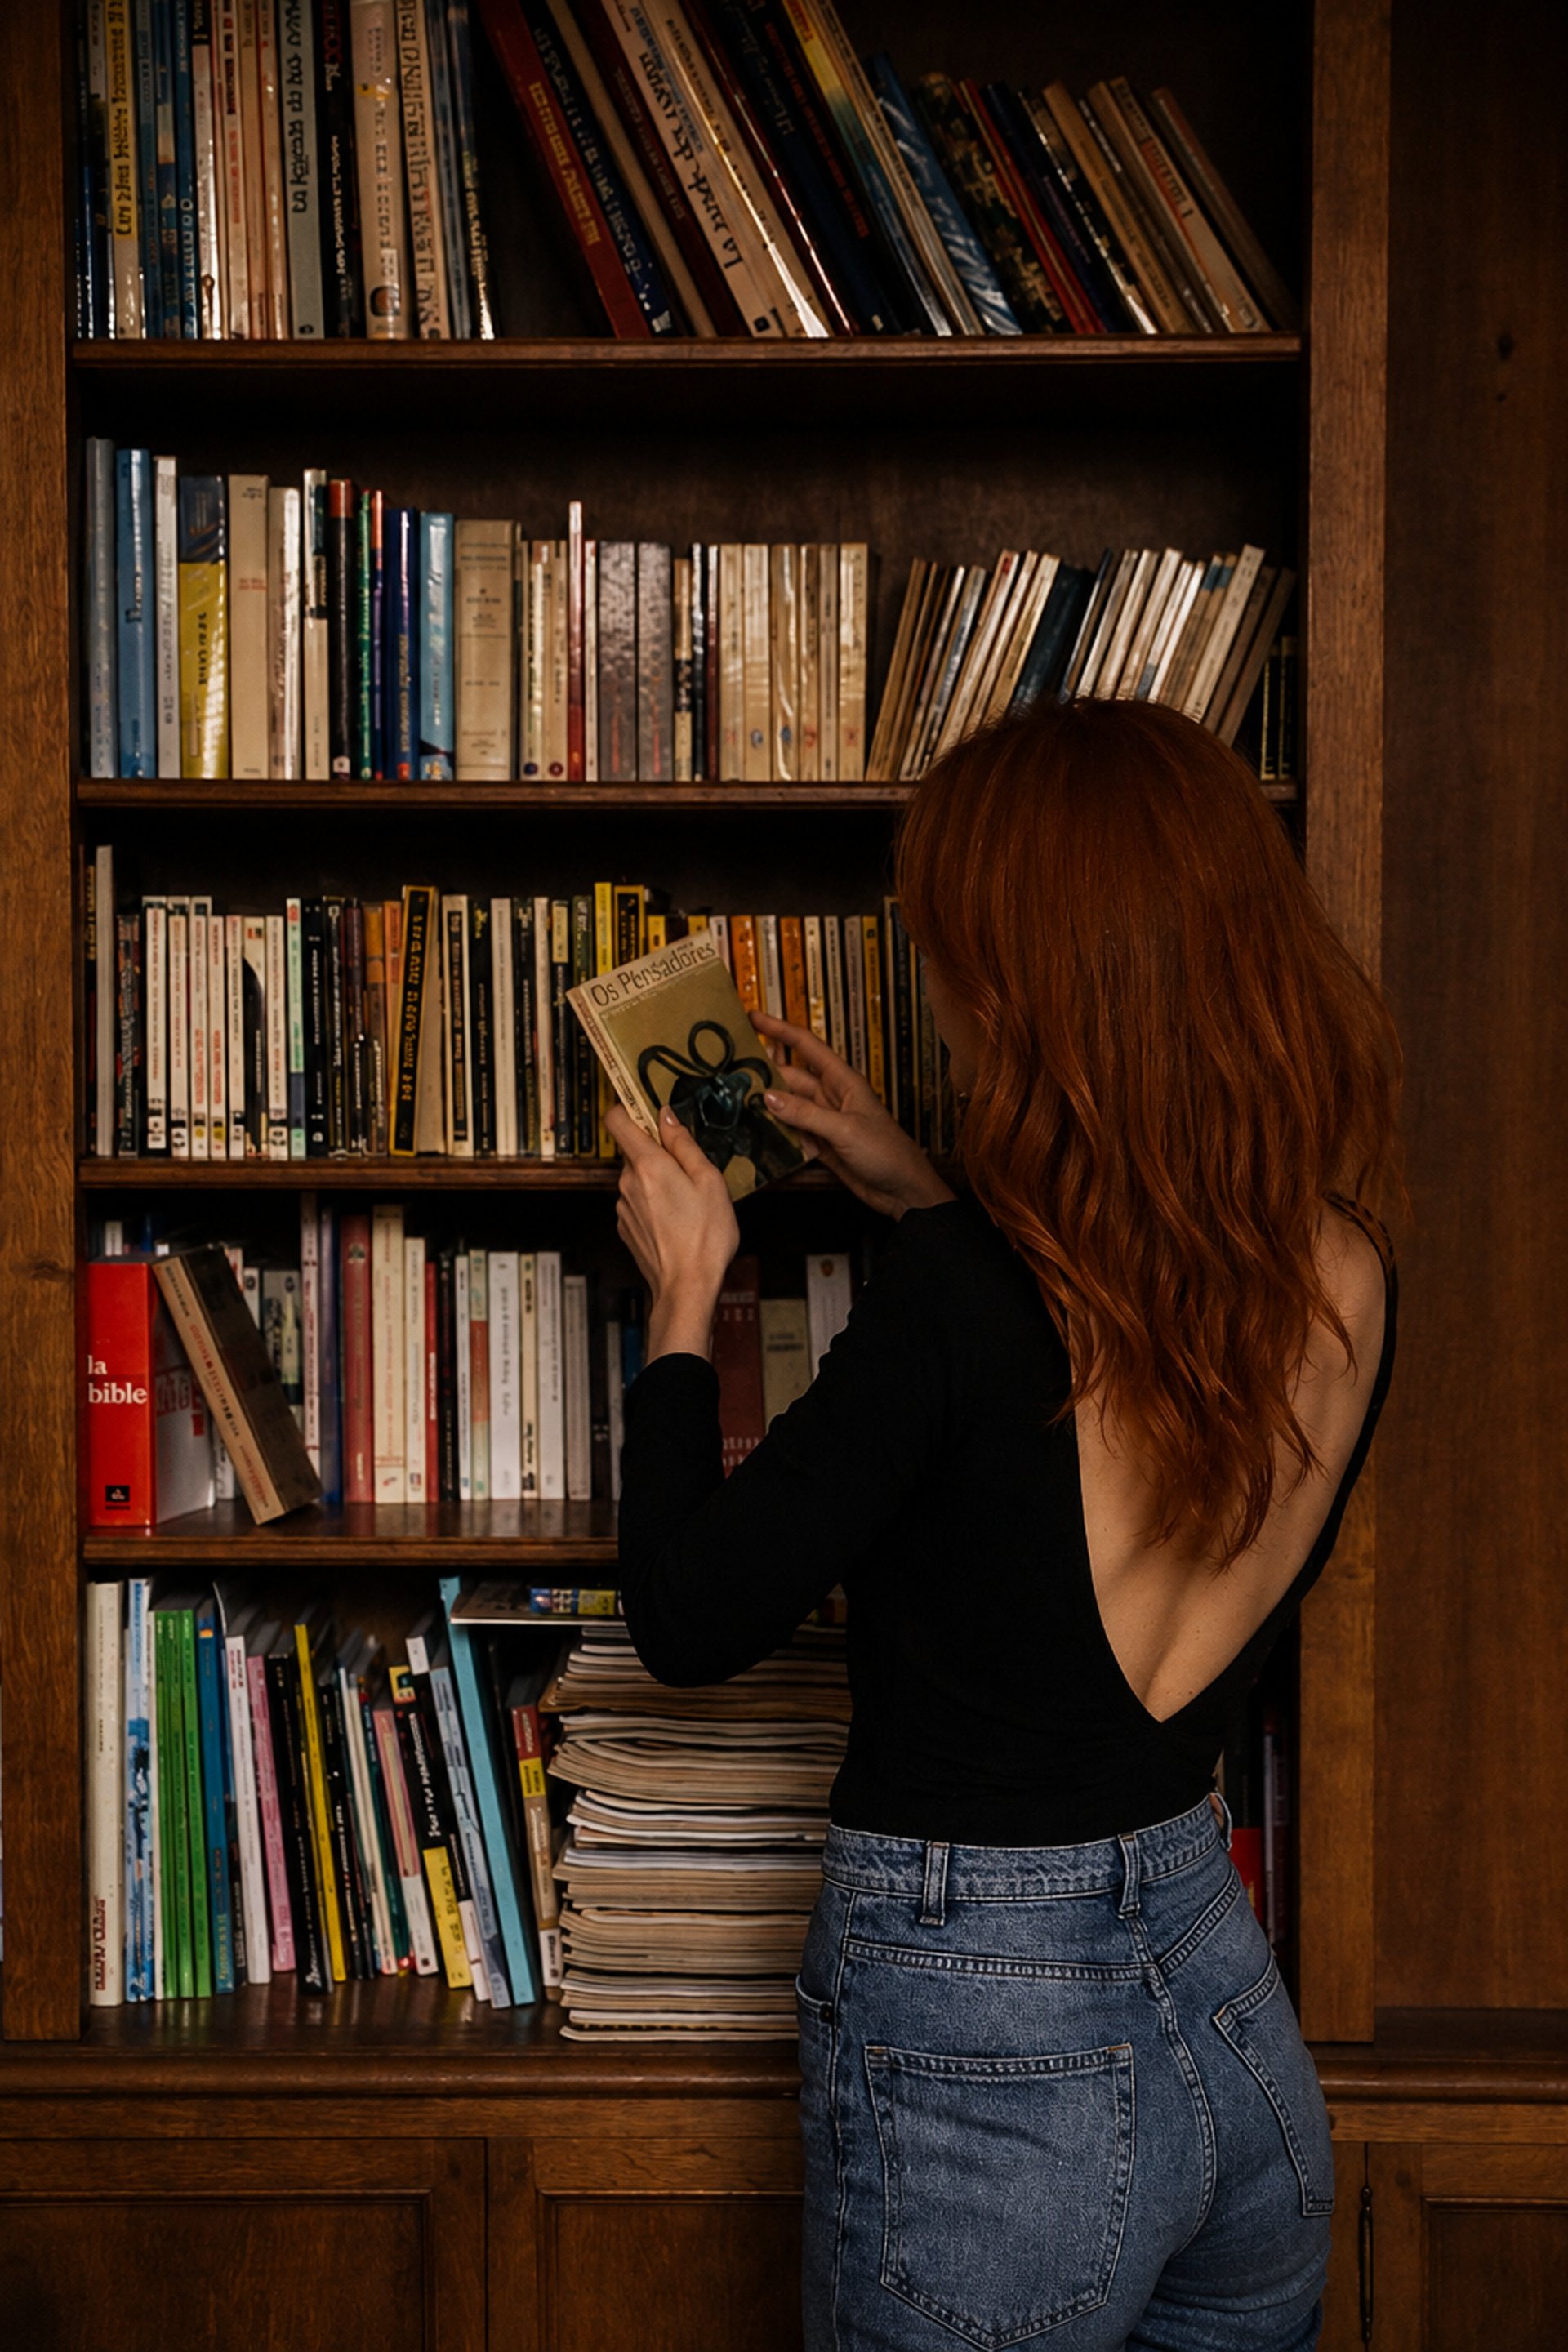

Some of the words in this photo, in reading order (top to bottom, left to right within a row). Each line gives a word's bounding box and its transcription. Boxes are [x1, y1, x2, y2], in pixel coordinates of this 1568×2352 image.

[590, 983, 620, 1007] Os
[617, 942, 716, 995] Pensadores
[87, 1354, 108, 1376] la
[87, 1383, 148, 1405] bible
